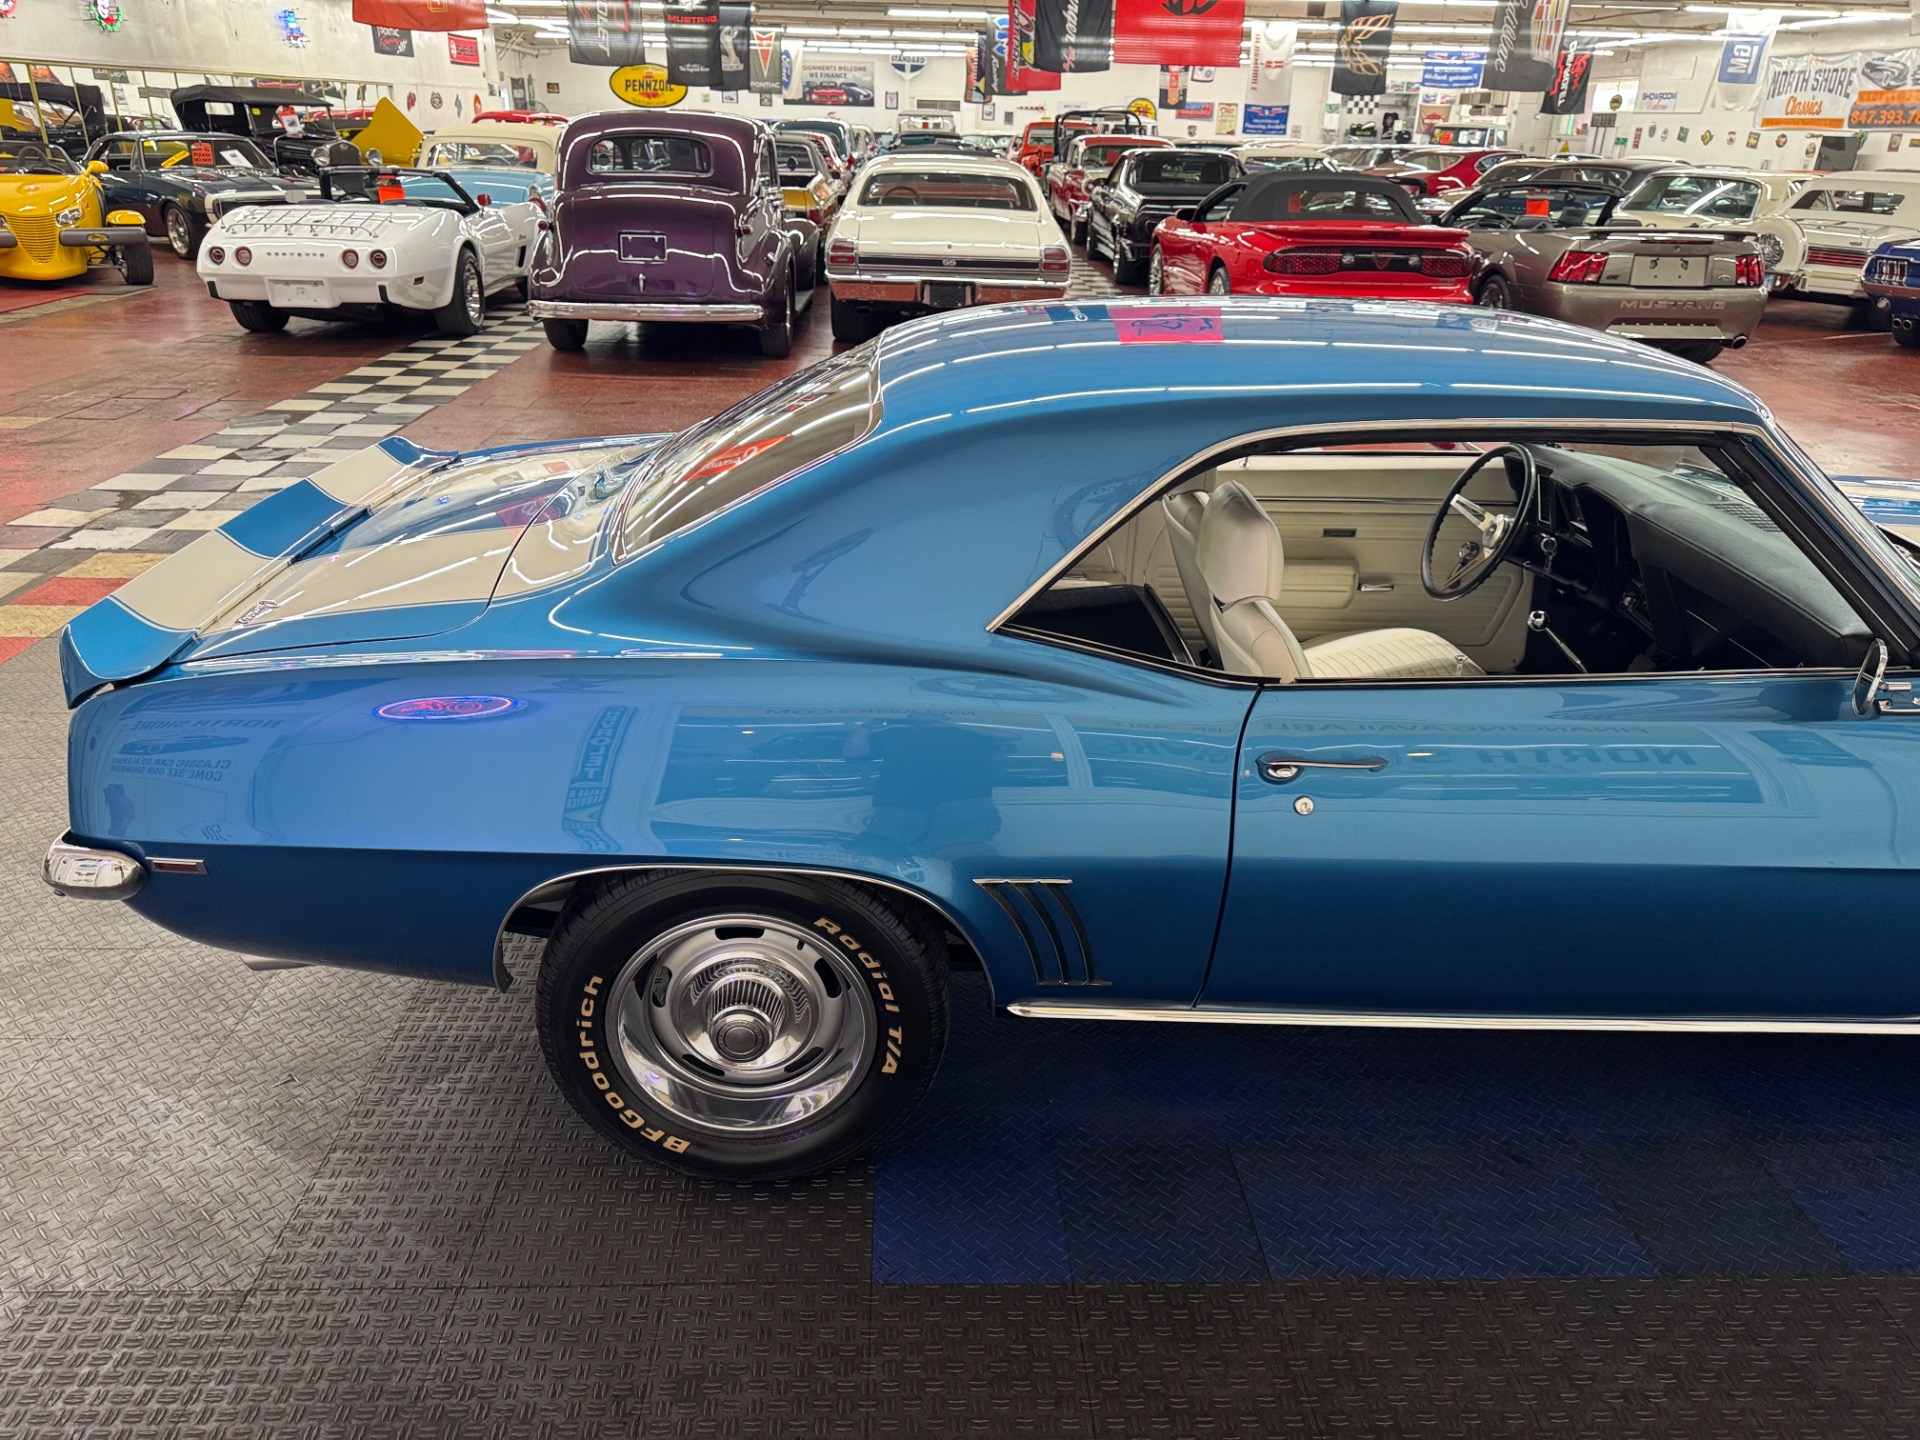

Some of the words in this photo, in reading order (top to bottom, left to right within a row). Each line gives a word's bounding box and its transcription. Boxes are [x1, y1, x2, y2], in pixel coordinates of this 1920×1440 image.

[596, 0, 611, 57] OLET
[667, 15, 717, 23] MUSTANG
[891, 55, 925, 63] STANDARD
[1727, 44, 1750, 74] GM
[625, 80, 674, 92] PENNZOIL
[751, 80, 780, 88] PONTIAC
[1766, 69, 1810, 100] NORTH
[1811, 67, 1857, 99] SHORE
[1784, 95, 1823, 115] Classics
[1620, 300, 1726, 310] MUSTANG
[813, 916, 900, 1013] Radial
[881, 1025, 903, 1074] T/A
[576, 975, 691, 1154] BFGoodrich
